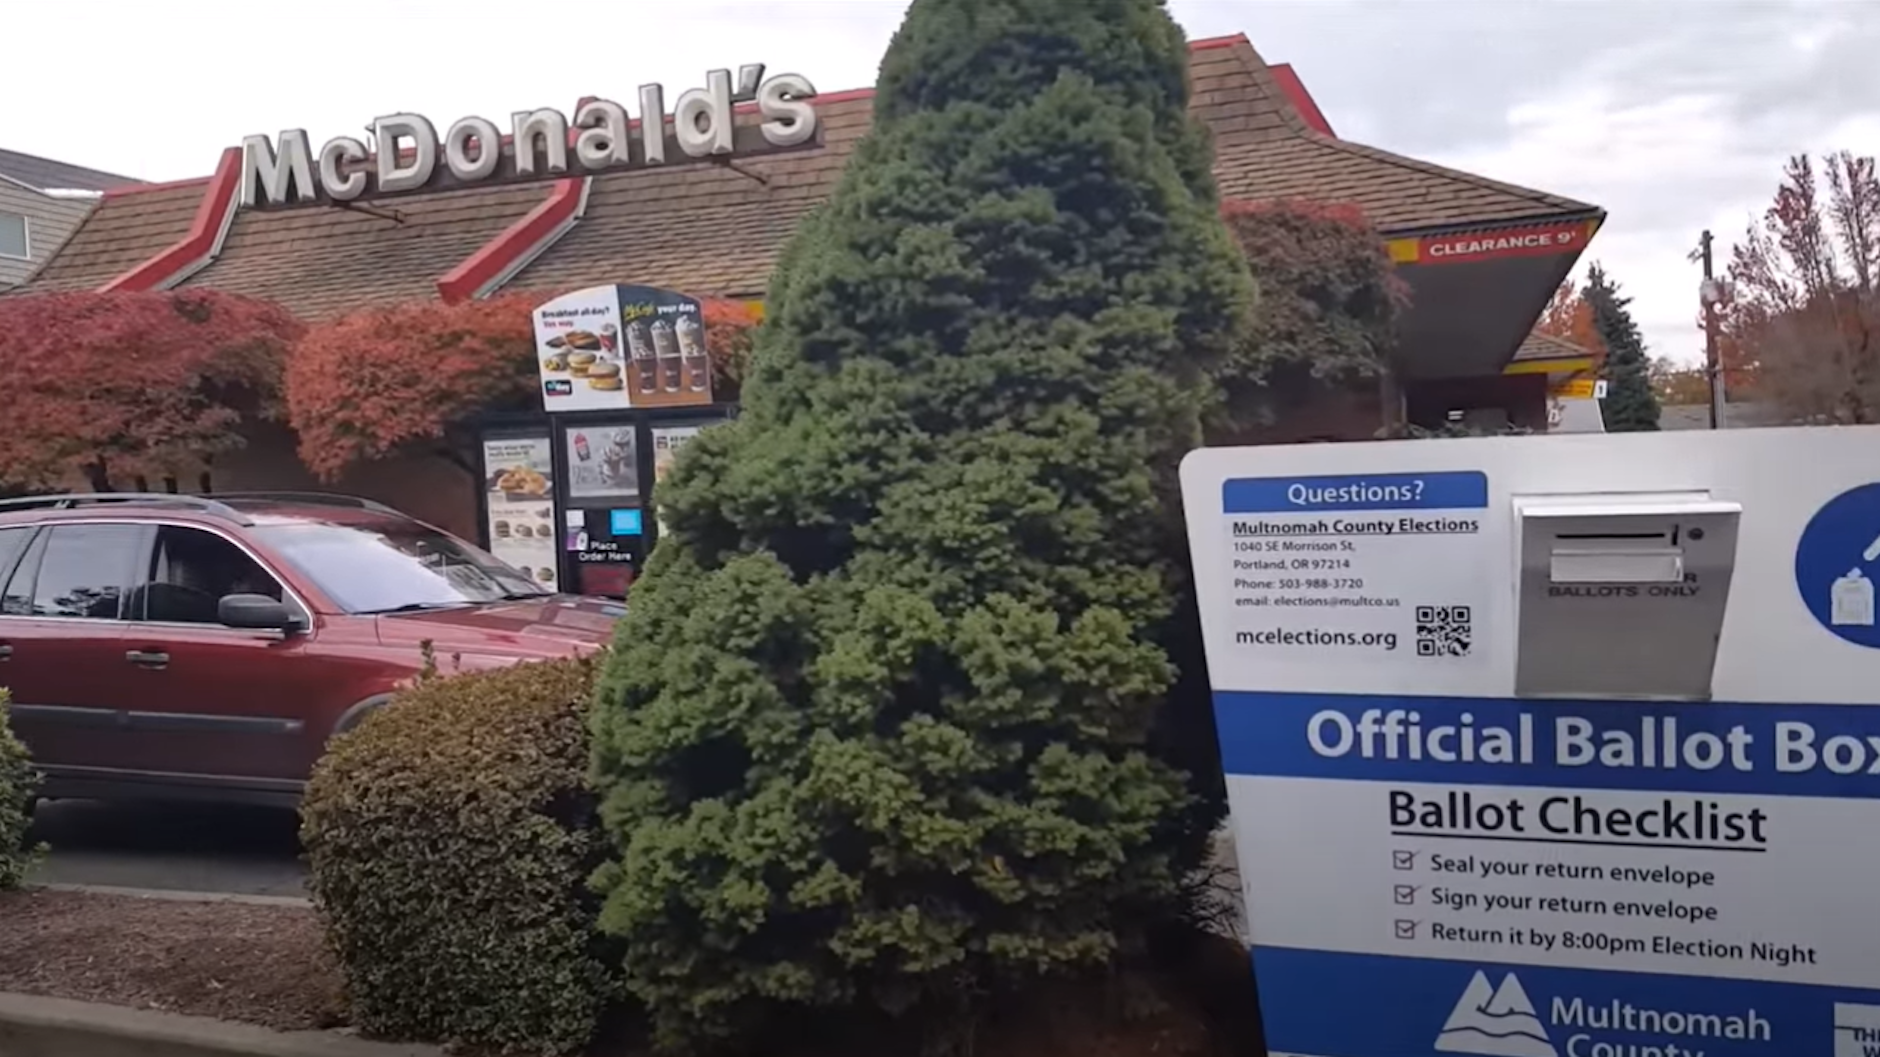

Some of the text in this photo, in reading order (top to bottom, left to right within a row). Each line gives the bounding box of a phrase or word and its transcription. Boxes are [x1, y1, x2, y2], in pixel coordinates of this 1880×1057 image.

[241, 63, 817, 207] McDonald's
[1429, 233, 1553, 256] CLEARANCE
[657, 305, 677, 315] your
[1288, 480, 1425, 505] Questions?
[1233, 517, 1479, 535] Multnomah County Elections
[579, 551, 632, 561] Order Here
[590, 541, 618, 551] Place
[1233, 541, 1263, 552] 1040
[1265, 541, 1280, 552] SE
[1282, 540, 1338, 551] Morrison
[1233, 559, 1351, 571] Portland, OR 97214
[1234, 578, 1364, 590] Phone: 503-988-3720
[1548, 585, 1700, 597] BALLOTS ONLY
[1235, 595, 1401, 607] email: elections@multco.us
[1236, 627, 1398, 650] mcelections.org
[1307, 709, 1533, 764] Official
[1555, 716, 1754, 771] Ballot
[1390, 791, 1768, 843] Ballot Checklist
[1431, 854, 1715, 888] Seal your return envelope
[1431, 887, 1719, 923] Sign your return envelope
[1431, 923, 1818, 966] Return it by 8:00pm Election Night
[1551, 997, 1772, 1040] Multnomah
[1850, 1027, 1880, 1043] TH
